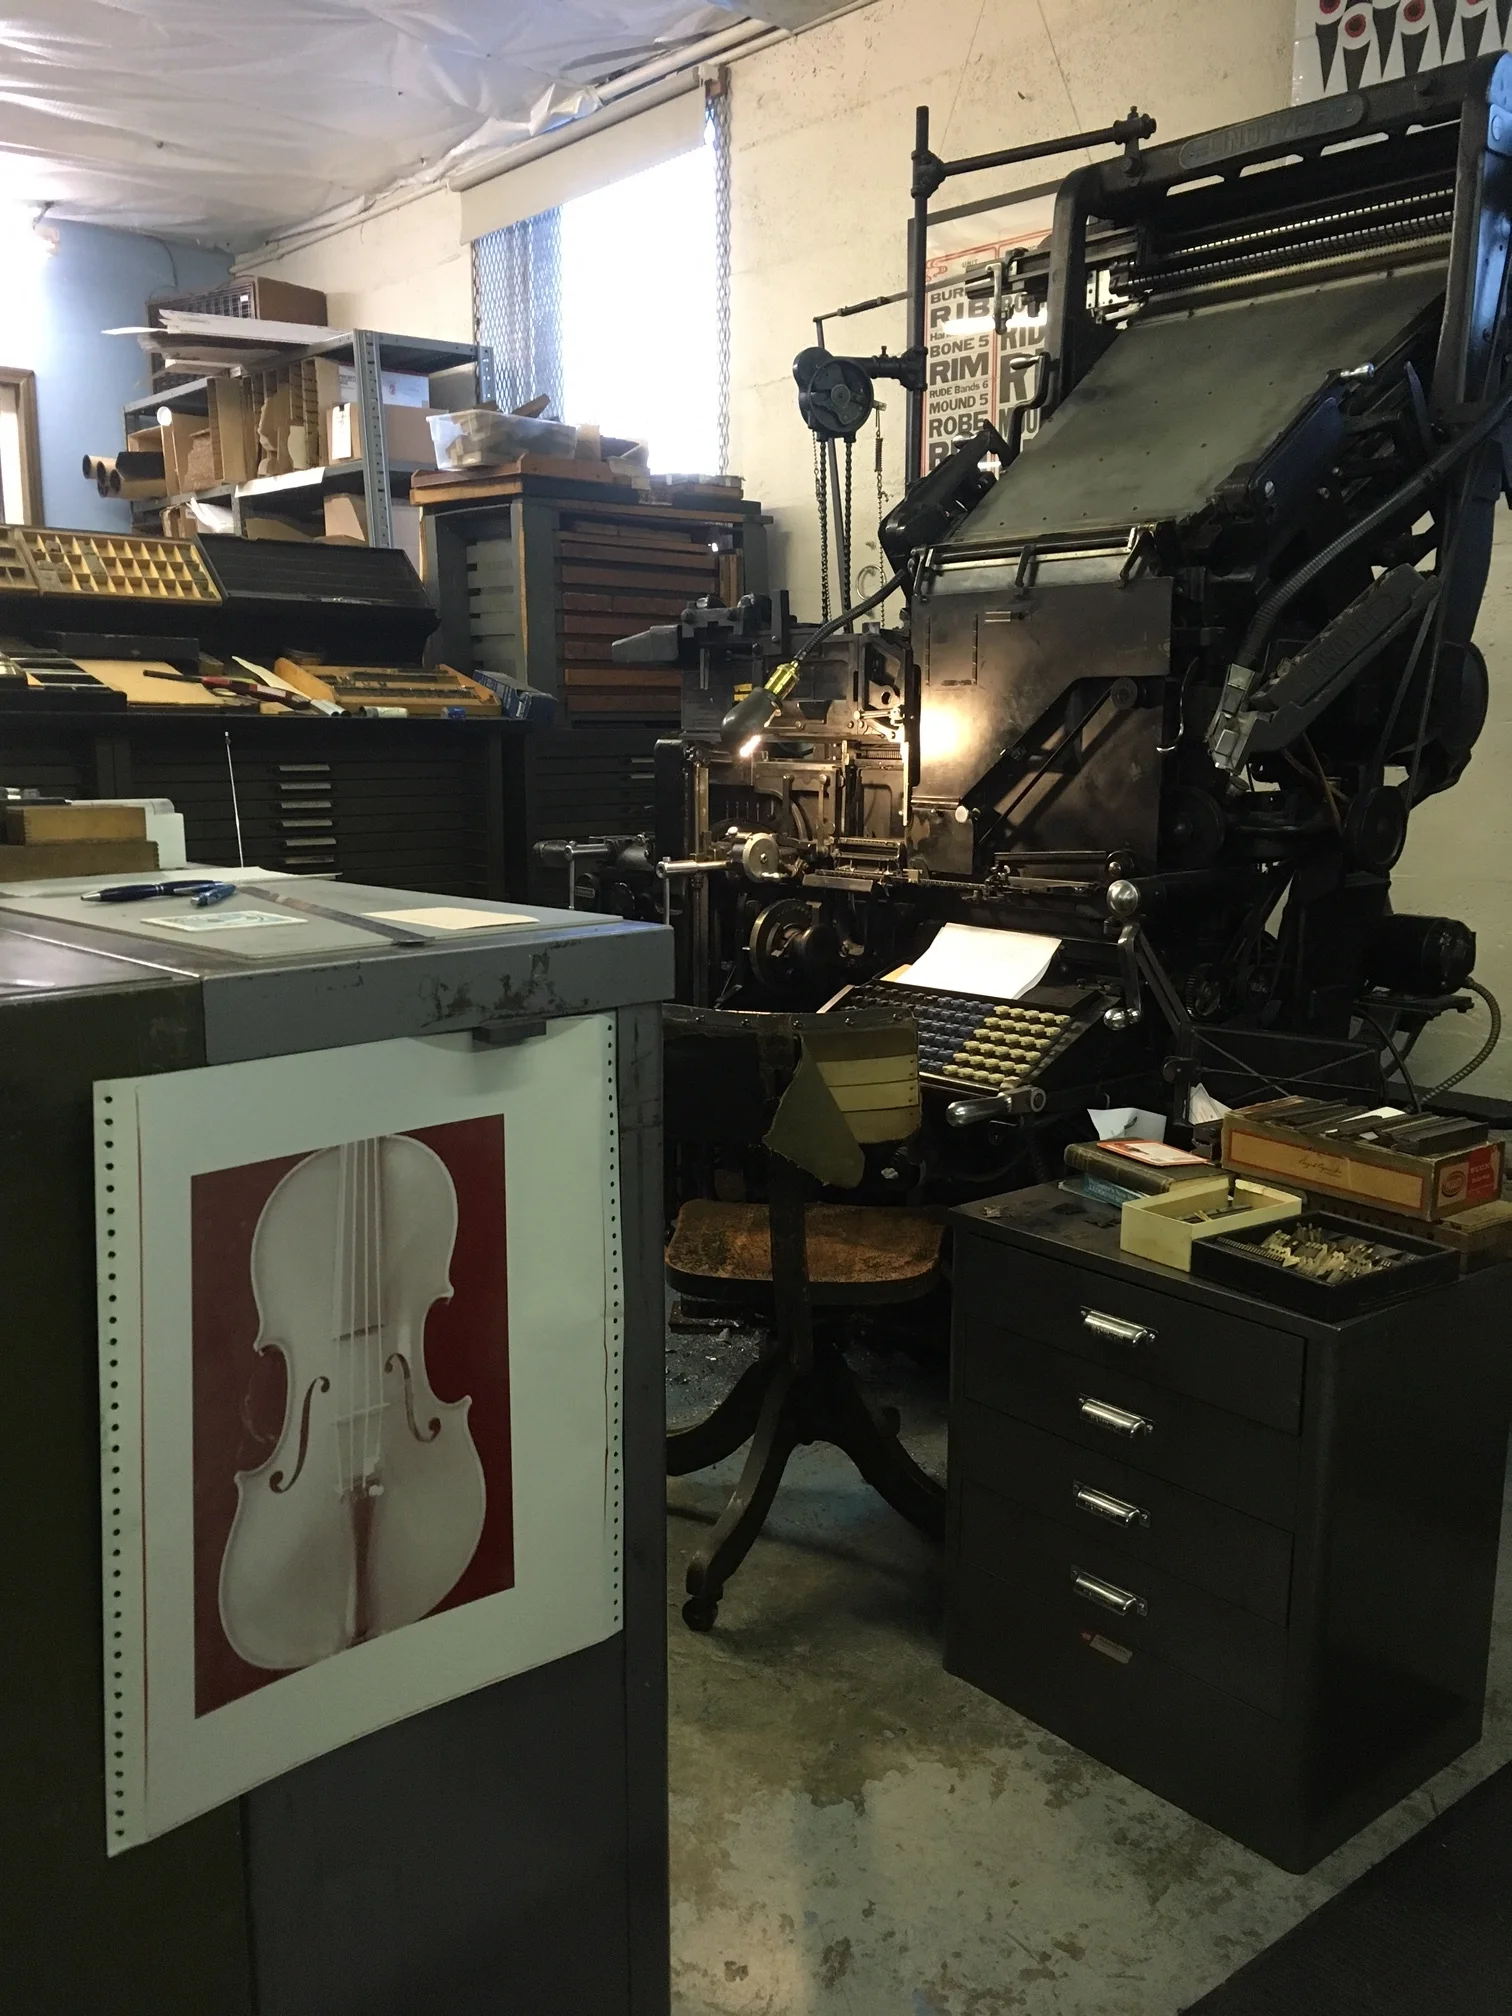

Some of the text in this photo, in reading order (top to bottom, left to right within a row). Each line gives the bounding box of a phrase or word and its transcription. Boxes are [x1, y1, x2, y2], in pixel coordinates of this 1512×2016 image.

[930, 287, 967, 304] BUR
[930, 334, 990, 359] BONE 5
[930, 351, 989, 386] RIM
[929, 380, 989, 399] RUDE Bands 6
[929, 393, 989, 415] MOUND 5
[929, 410, 989, 438] ROBE
